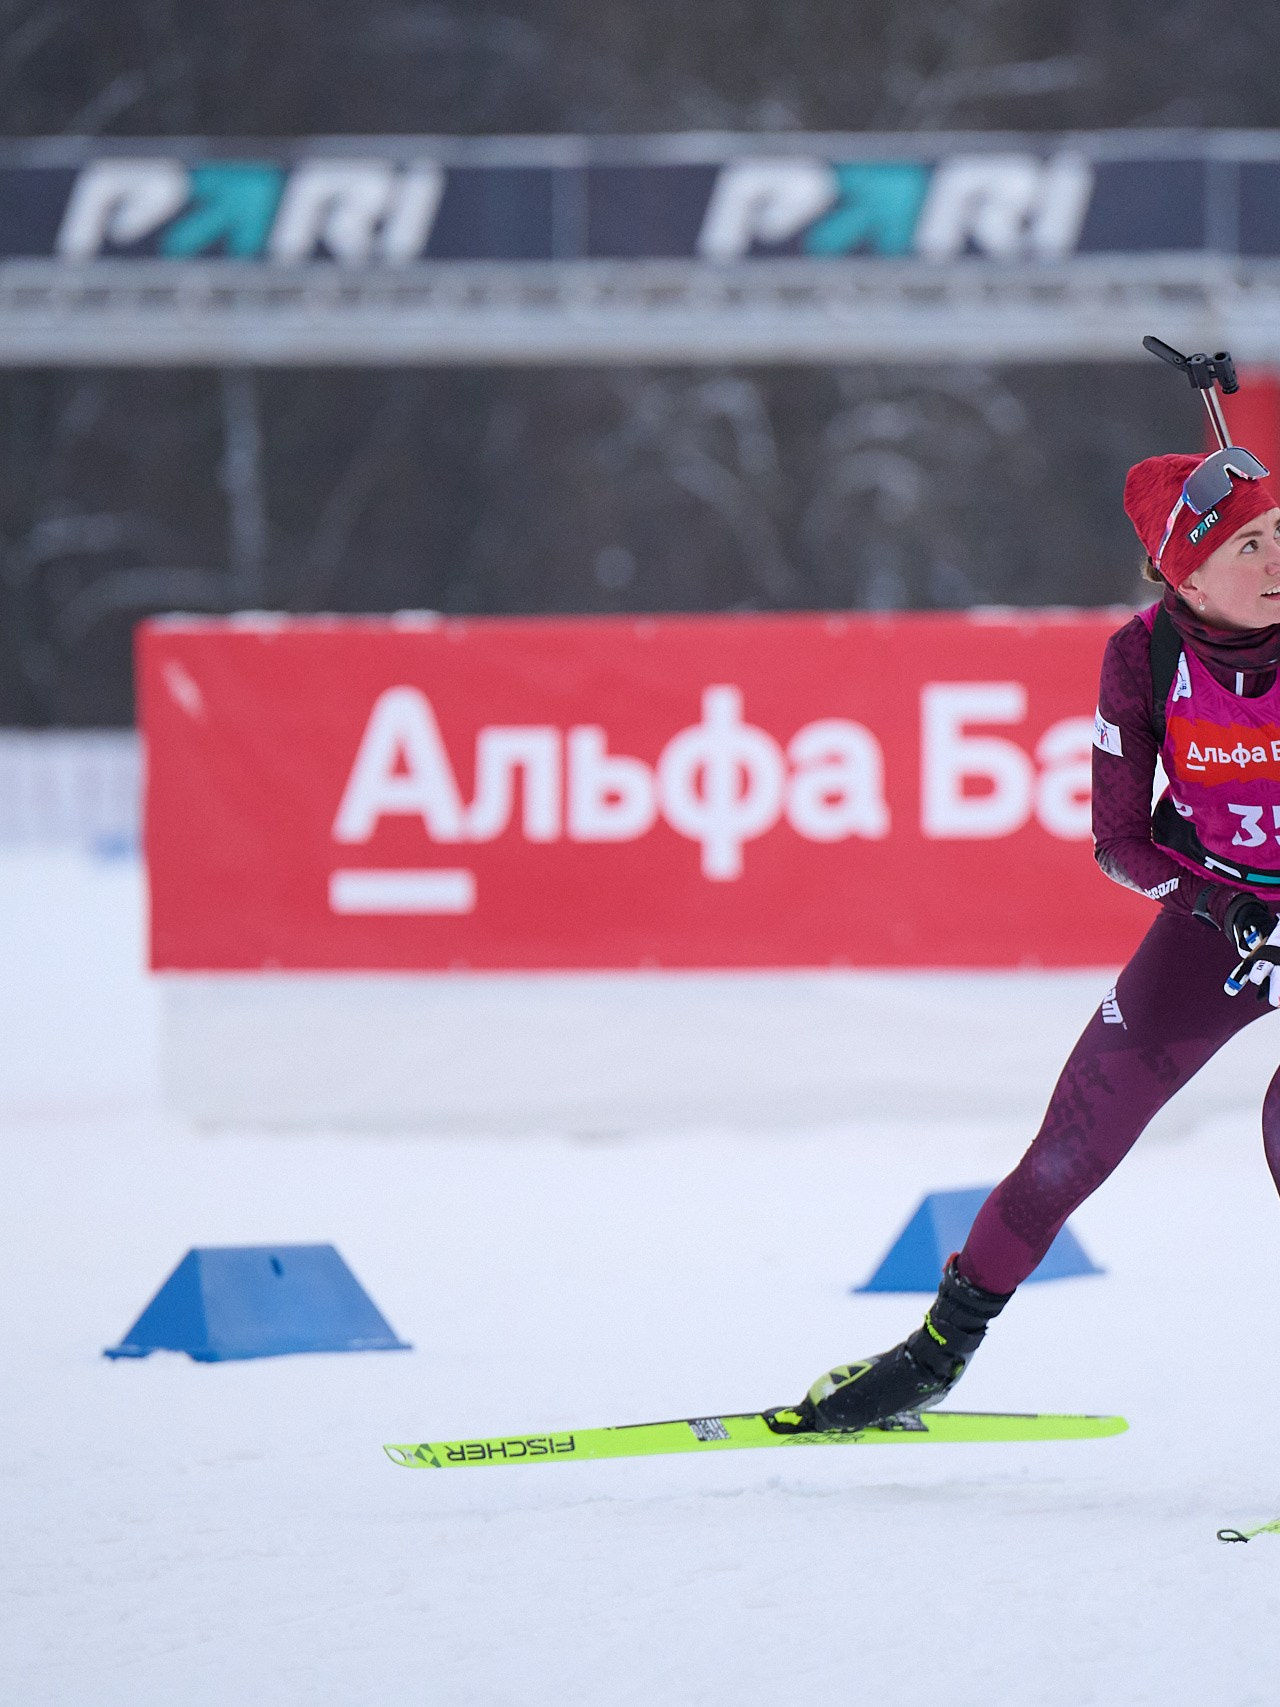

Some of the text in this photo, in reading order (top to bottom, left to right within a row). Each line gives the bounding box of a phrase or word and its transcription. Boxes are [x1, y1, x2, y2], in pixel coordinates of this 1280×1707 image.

[1187, 741, 1268, 768] Альфа
[331, 680, 1093, 882] Альфа Ба
[446, 1435, 576, 1461] FISCHER
